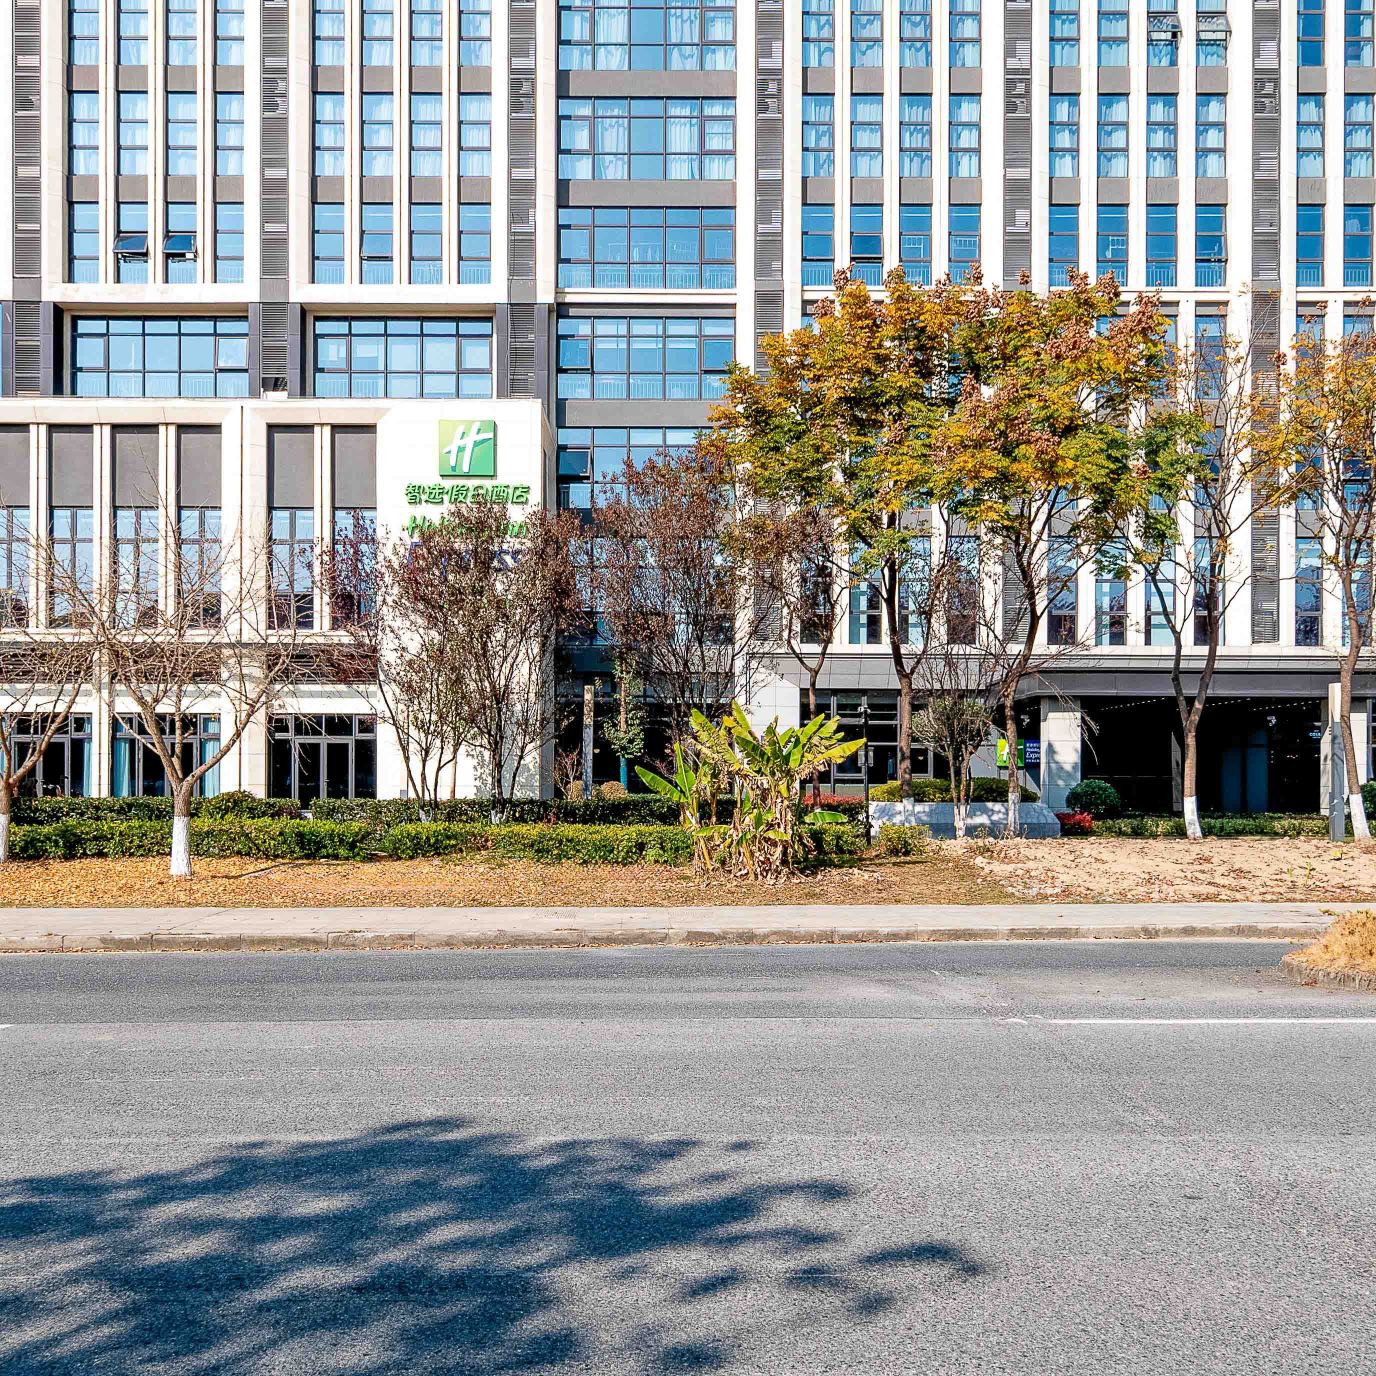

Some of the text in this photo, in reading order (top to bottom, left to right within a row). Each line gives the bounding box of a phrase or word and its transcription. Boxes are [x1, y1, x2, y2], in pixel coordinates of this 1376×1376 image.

[405, 483, 531, 505] 智选假日酒店
